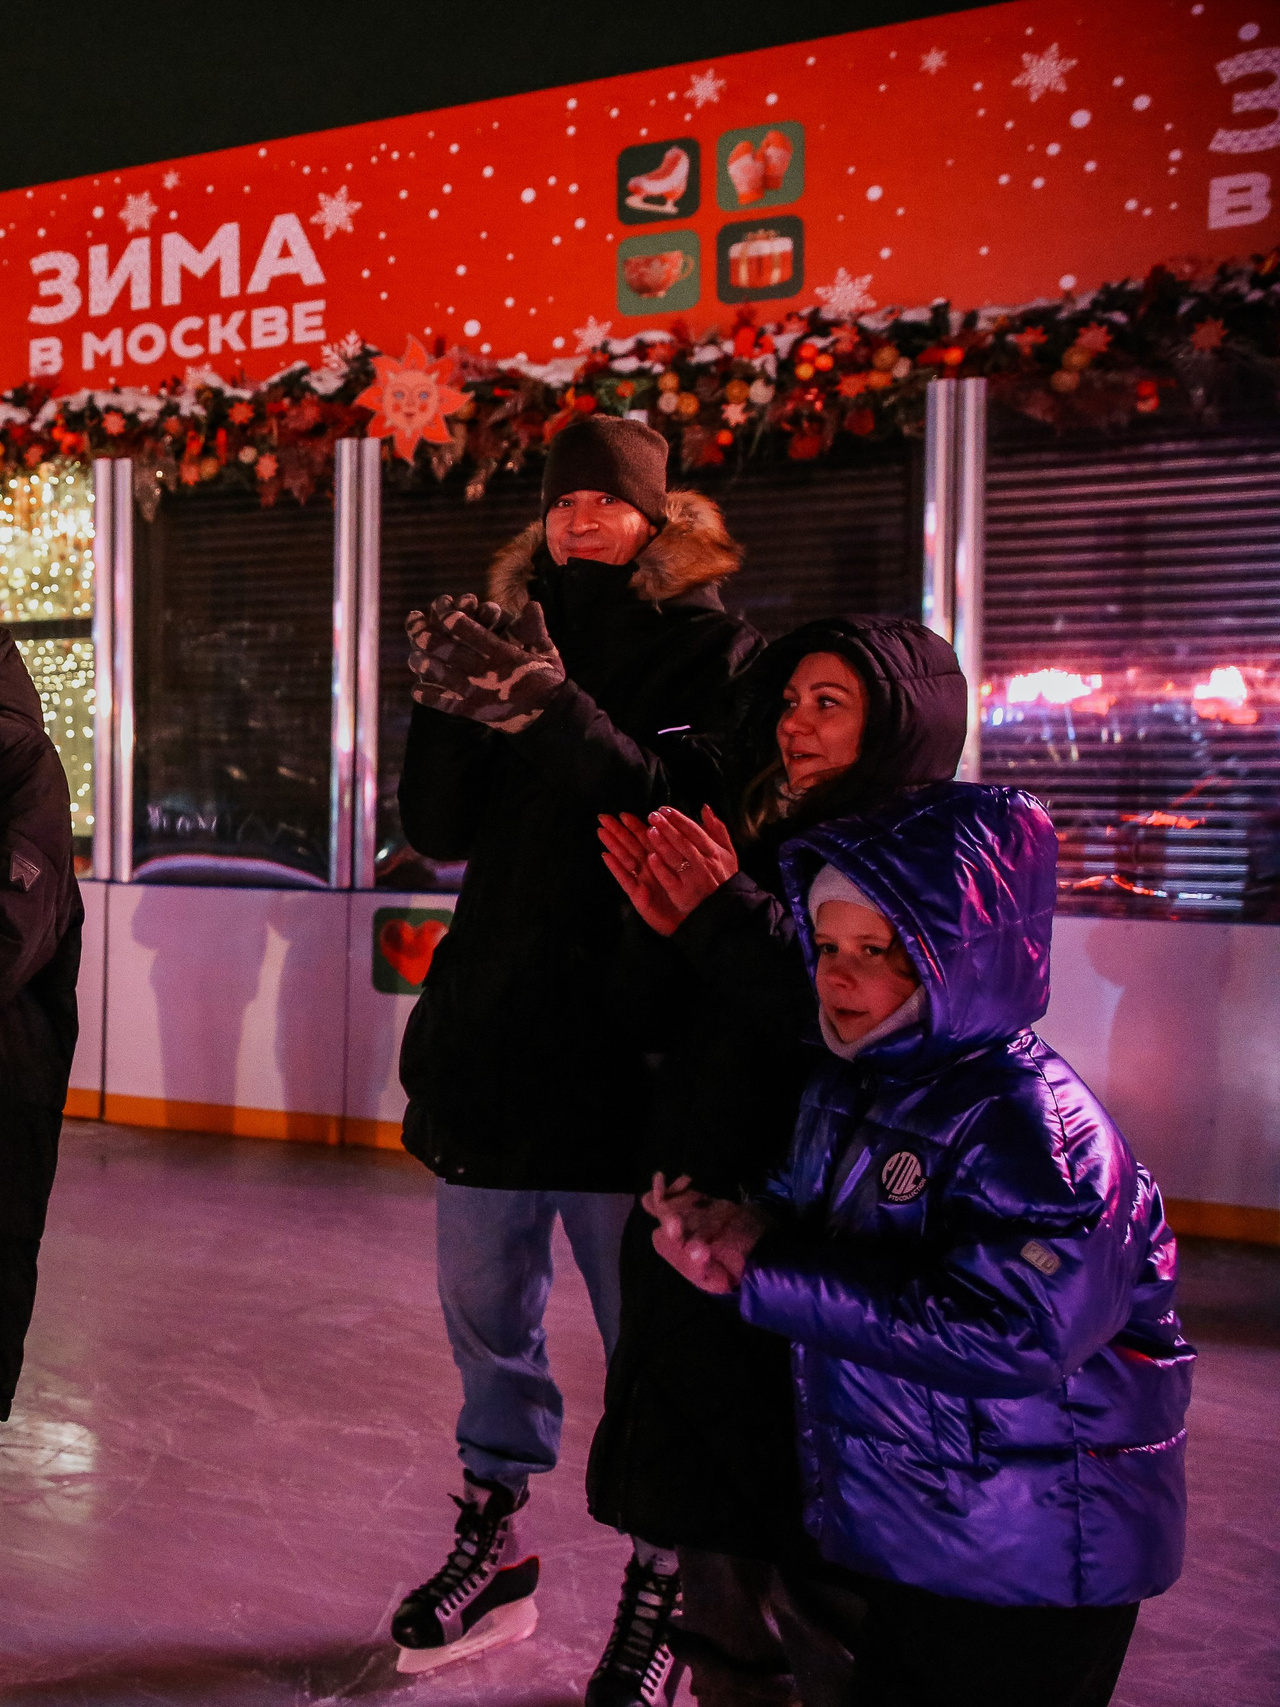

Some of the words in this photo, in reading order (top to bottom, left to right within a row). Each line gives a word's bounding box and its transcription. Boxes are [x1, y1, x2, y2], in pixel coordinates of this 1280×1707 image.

[1208, 172, 1271, 230] В
[27, 213, 326, 325] ЗИМА
[29, 337, 63, 377] В
[82, 299, 326, 371] МОСКВЕ
